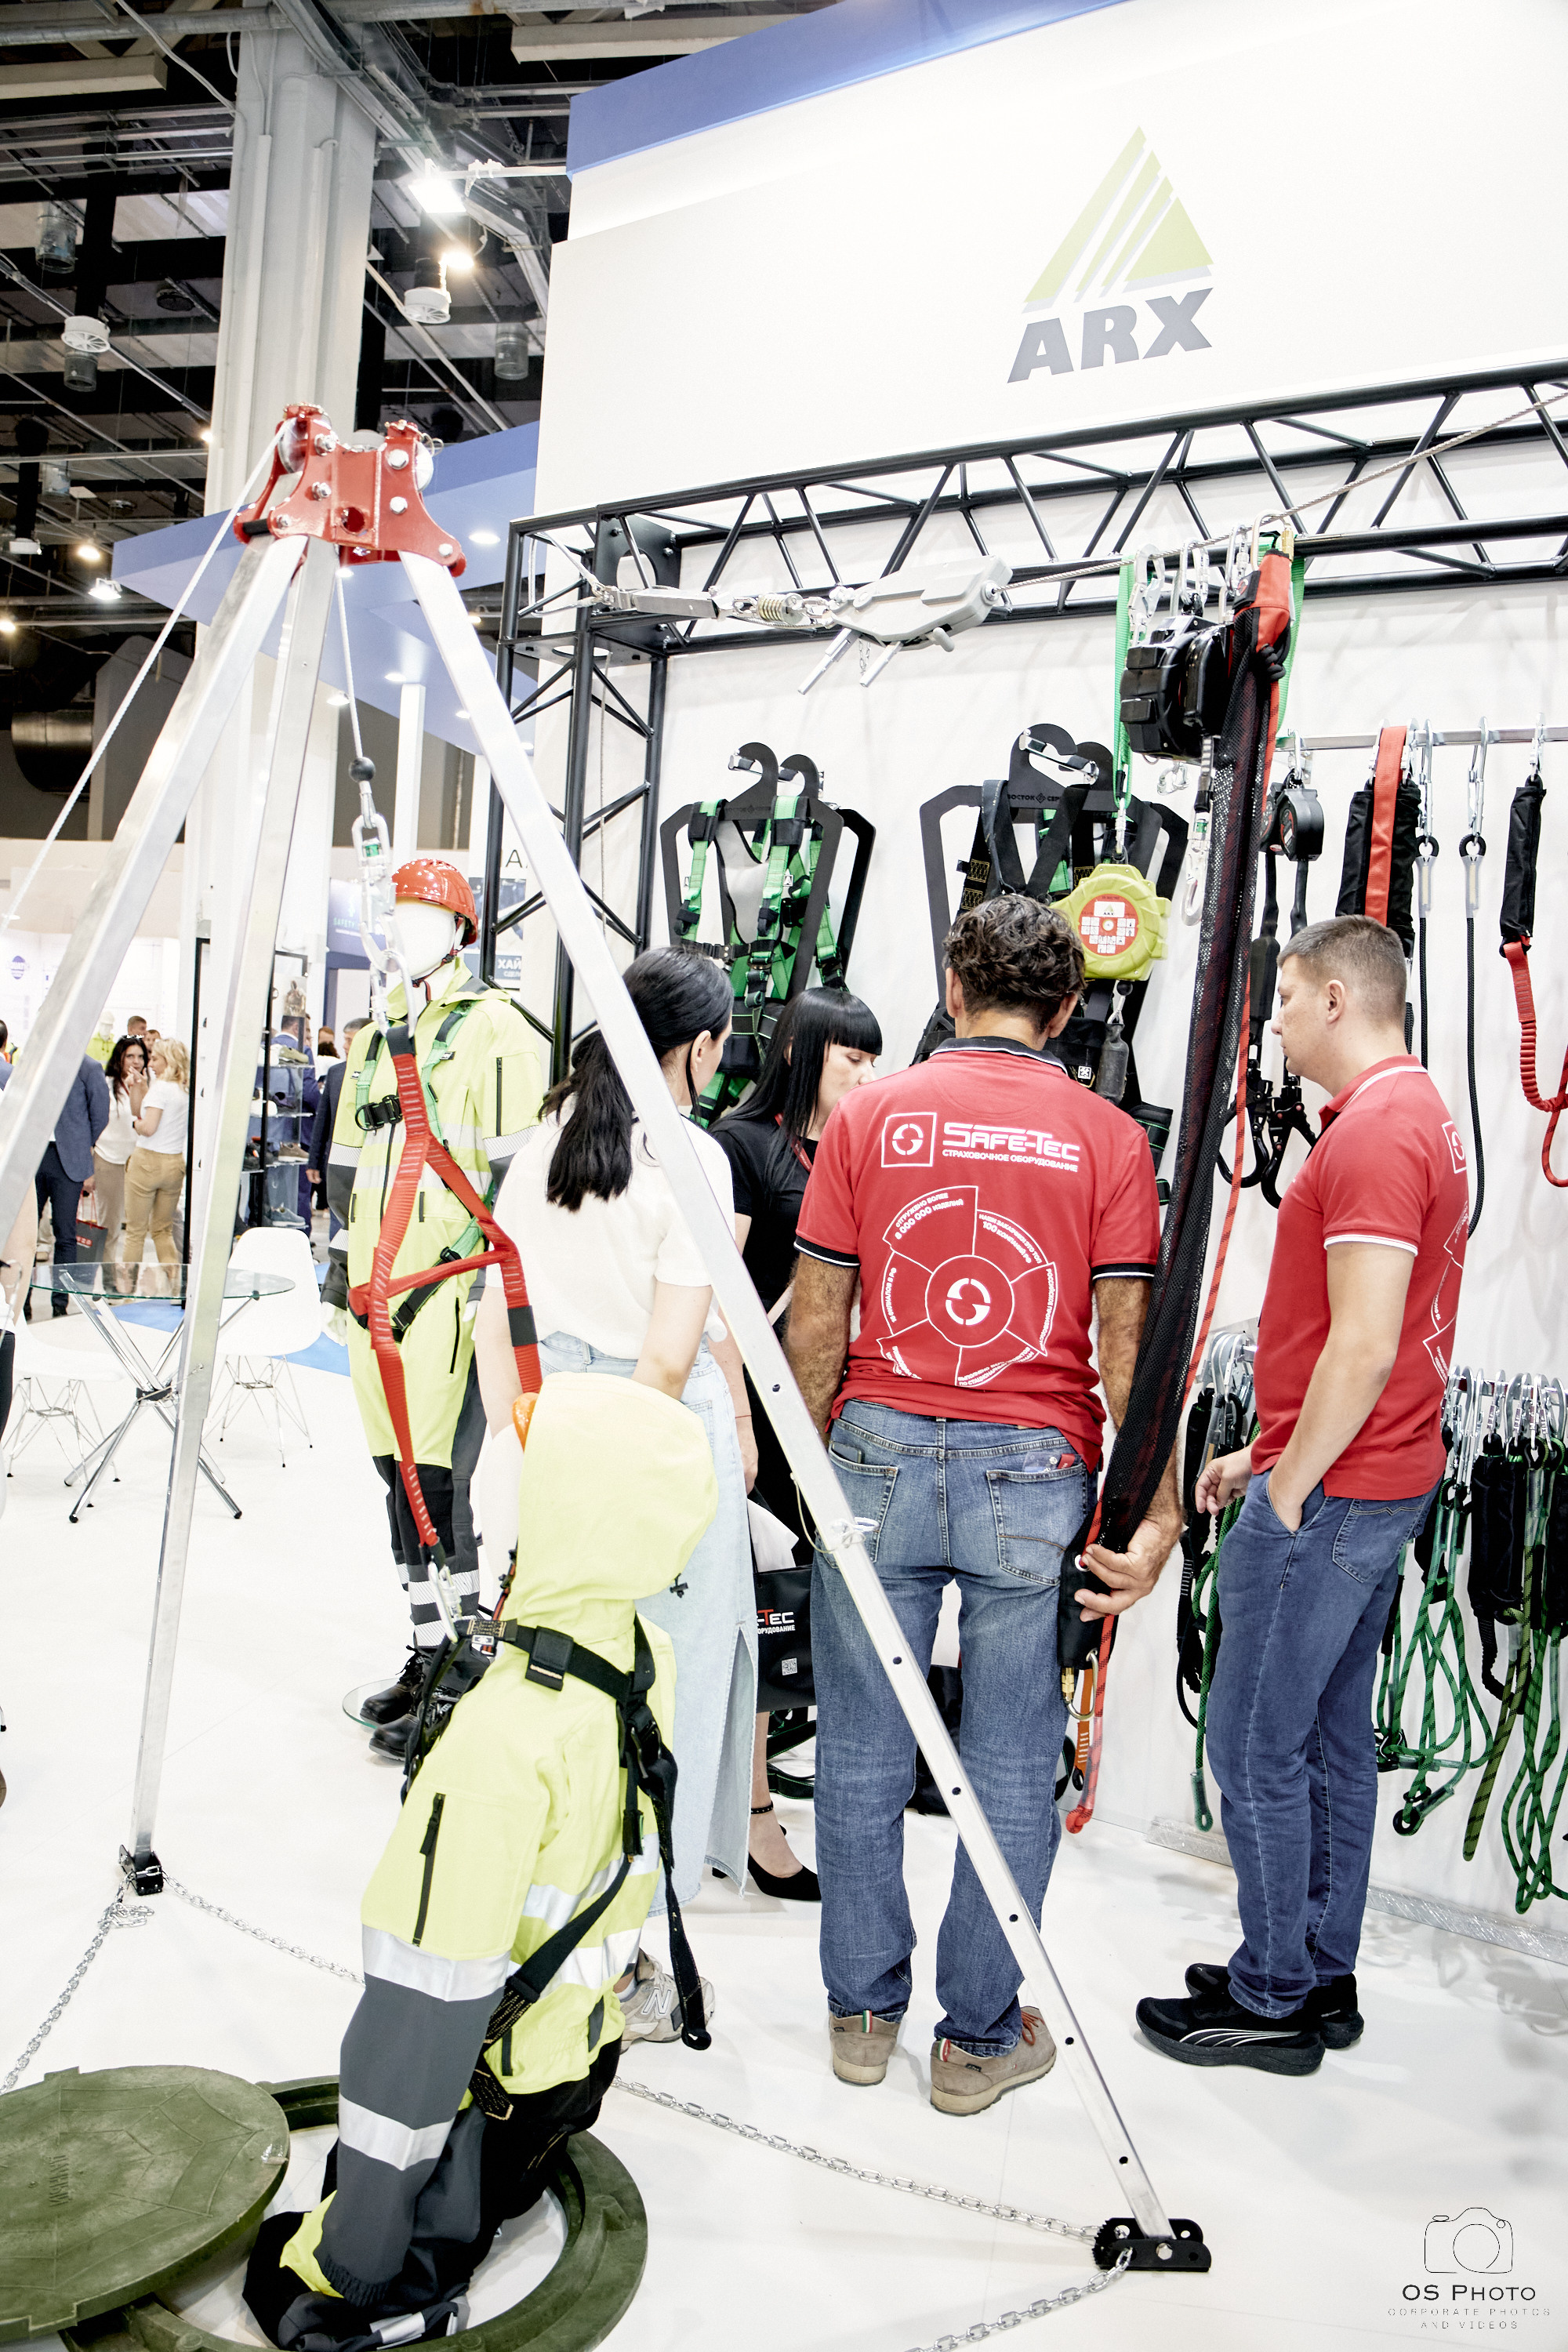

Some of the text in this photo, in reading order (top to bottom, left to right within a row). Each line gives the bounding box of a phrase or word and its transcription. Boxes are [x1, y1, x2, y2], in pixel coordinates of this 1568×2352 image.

[1007, 287, 1214, 383] ARX
[942, 1122, 1080, 1161] SAFE-TEC
[942, 1149, 1079, 1172] СТРАХОВОЧНОЕ ОБОРУДОВАНИЕ
[899, 1218, 916, 1234] 000
[914, 1207, 932, 1221] 000
[932, 1199, 964, 1210] ИЗДЕЛИЙ
[982, 1221, 997, 1232] 100
[757, 1609, 795, 1625] -TEC
